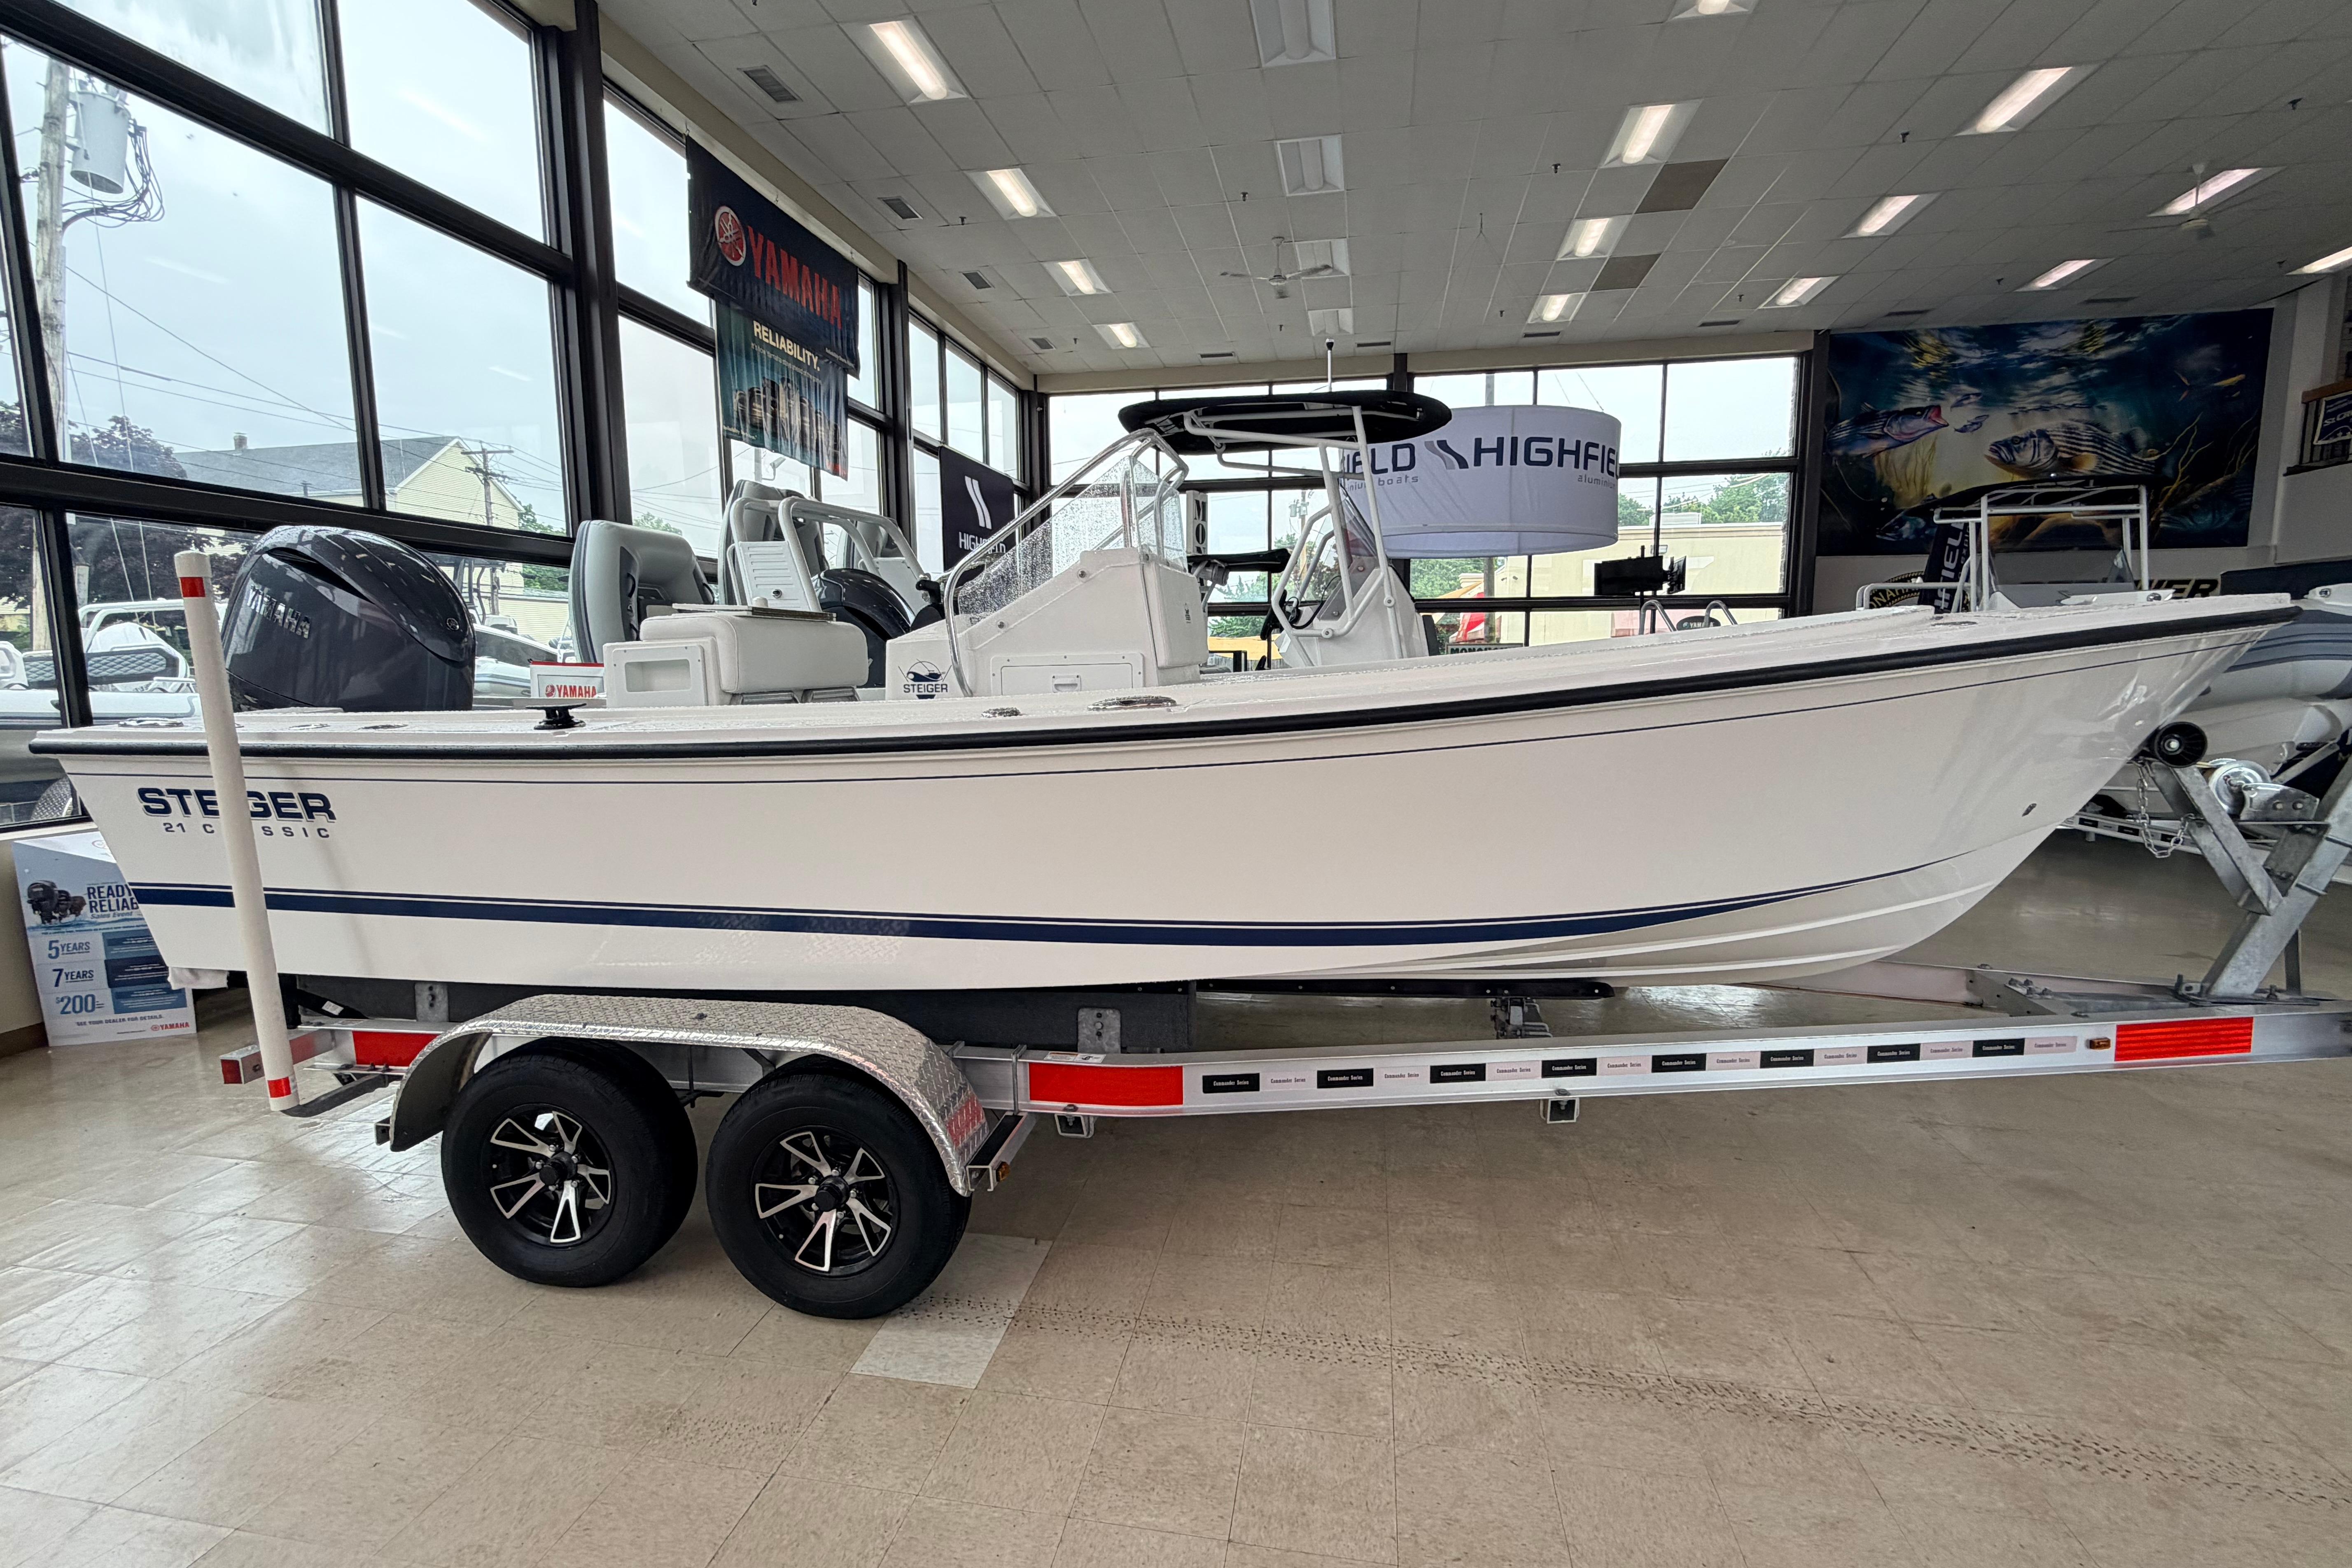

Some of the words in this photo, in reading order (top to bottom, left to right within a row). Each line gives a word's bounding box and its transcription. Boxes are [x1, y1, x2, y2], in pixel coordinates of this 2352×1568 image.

[747, 225, 842, 329] YAMAHA
[753, 320, 820, 371] RELIABILITY.
[1378, 474, 1419, 486] boats
[247, 586, 310, 639] YAMAHA
[556, 684, 597, 698] YAMAHA
[903, 684, 948, 693] STEIGER
[137, 788, 337, 823] STEGER
[163, 823, 186, 833] 21
[203, 824, 329, 838] CSSIC
[48, 940, 59, 959] 5
[60, 942, 91, 952] YEARS
[52, 968, 64, 987] 7
[64, 970, 94, 980] YEARS
